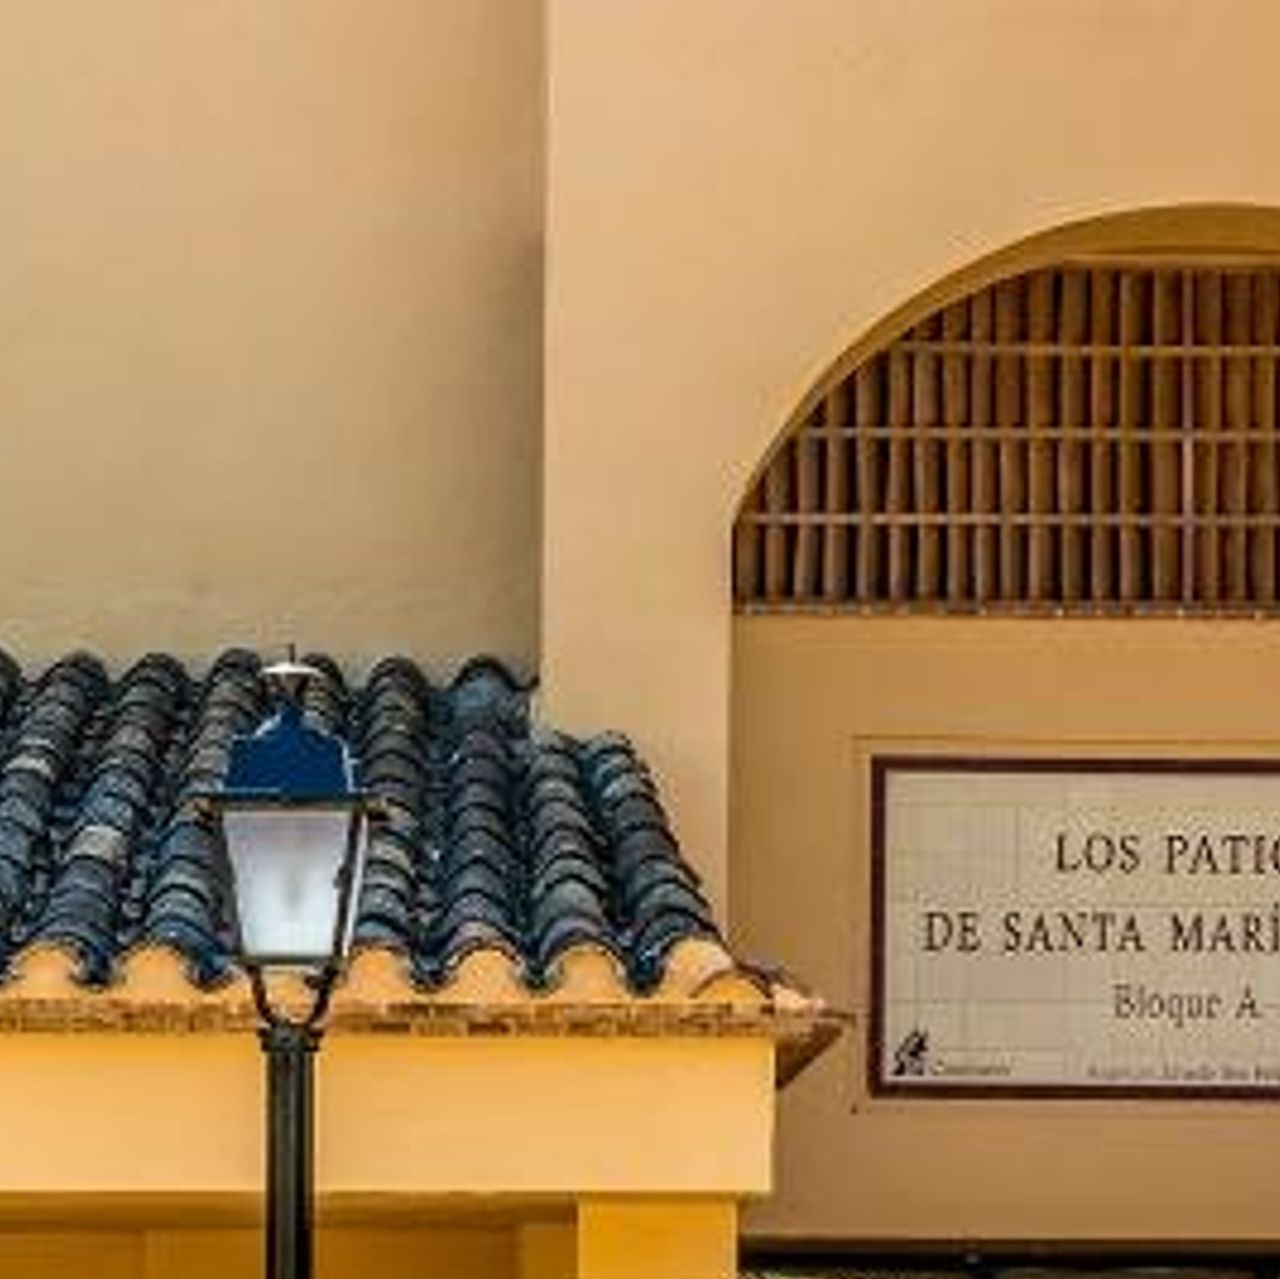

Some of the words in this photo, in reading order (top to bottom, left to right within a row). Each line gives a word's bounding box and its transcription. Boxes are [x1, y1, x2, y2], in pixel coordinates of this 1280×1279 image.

[1055, 833, 1140, 875] LOS
[923, 911, 981, 952] DE
[1003, 911, 1146, 952] SANTA
[1113, 983, 1223, 1029] Bloque
[1234, 982, 1263, 1019] A
